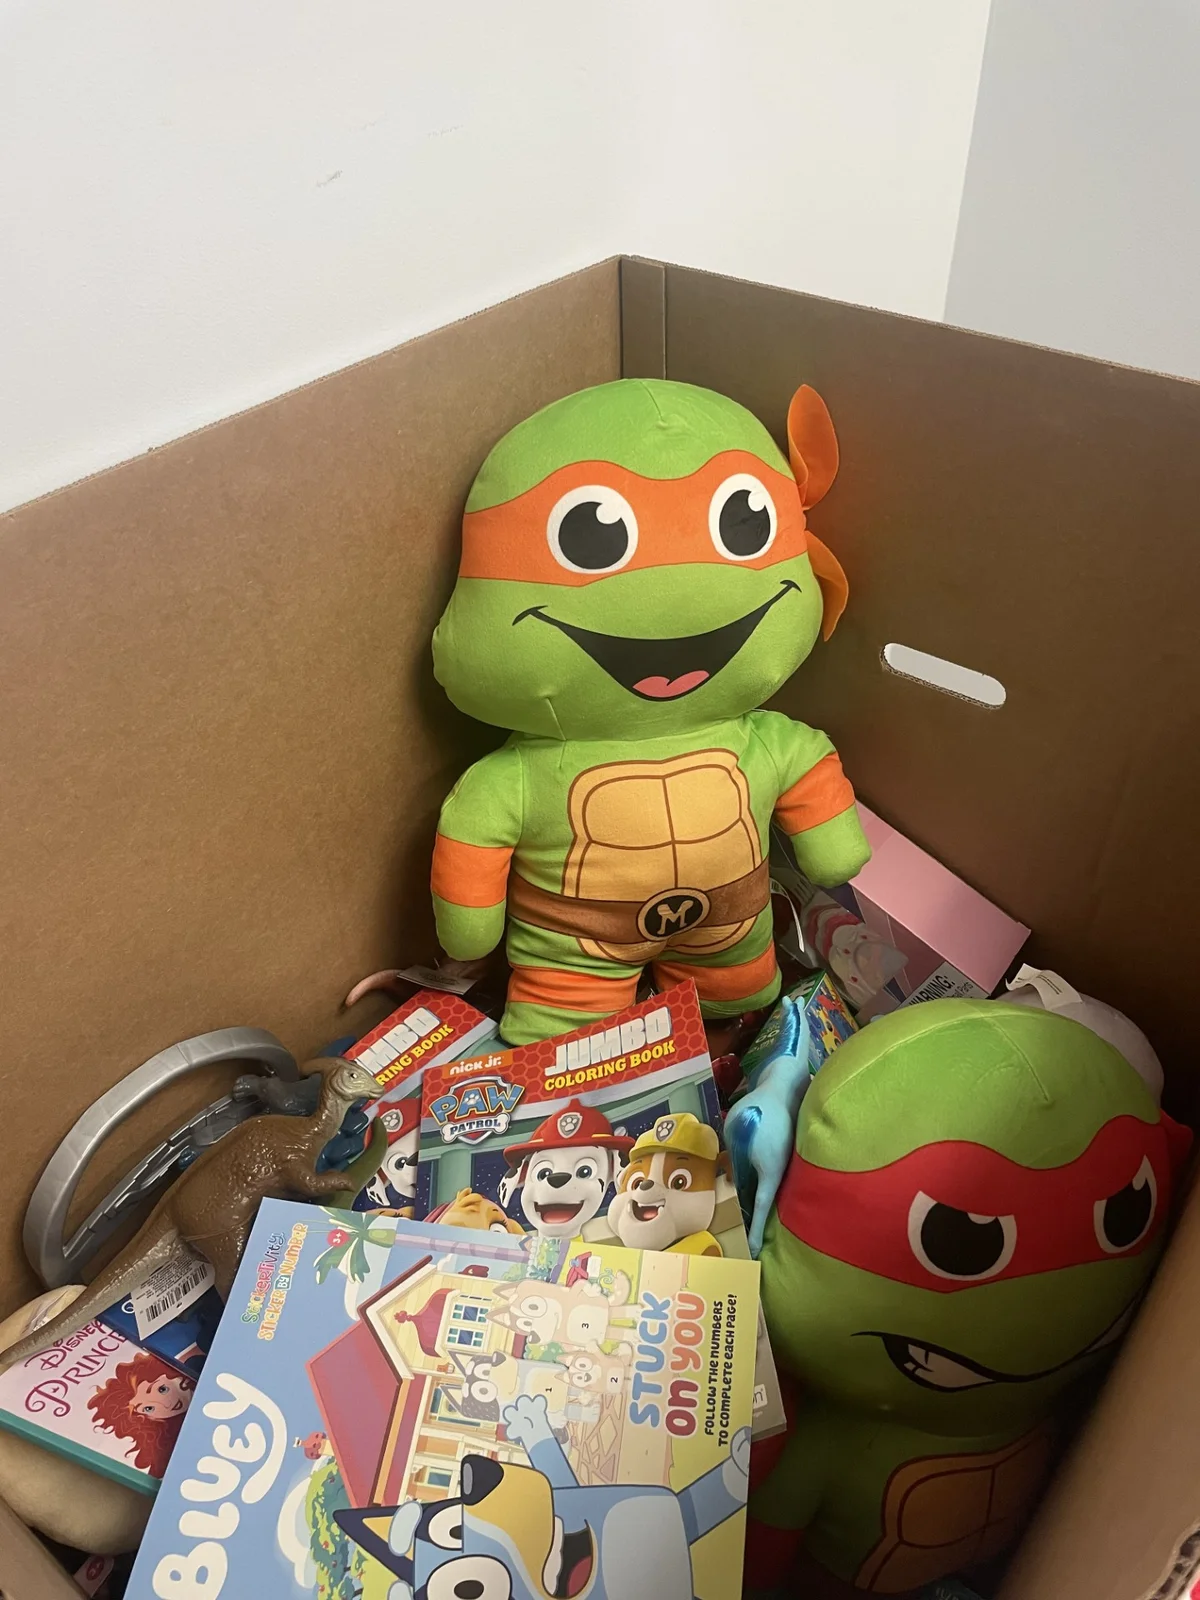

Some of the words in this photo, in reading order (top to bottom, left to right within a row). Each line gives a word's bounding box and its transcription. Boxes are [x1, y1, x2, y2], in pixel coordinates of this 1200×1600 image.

[656, 899, 694, 935] M
[354, 1006, 441, 1077] MBO
[375, 1056, 413, 1087] RING
[411, 1024, 455, 1059] BOOK
[449, 1060, 483, 1075] nick
[485, 1055, 502, 1069] jr.
[544, 1005, 673, 1077] JUMBO
[544, 1056, 628, 1092] COLORING
[629, 1039, 677, 1068] BOOK
[428, 1082, 526, 1126] PAW
[449, 1117, 502, 1137] PATROL
[332, 1232, 342, 1244] 3+
[258, 1290, 287, 1341] STICKER
[670, 1292, 705, 1372] YOU
[24, 1329, 128, 1418] PRINCE
[628, 1291, 671, 1429] STUCK
[704, 1387, 718, 1436] FOLLOW
[718, 1430, 729, 1447] TO
[152, 1372, 288, 1600] BLUEY
